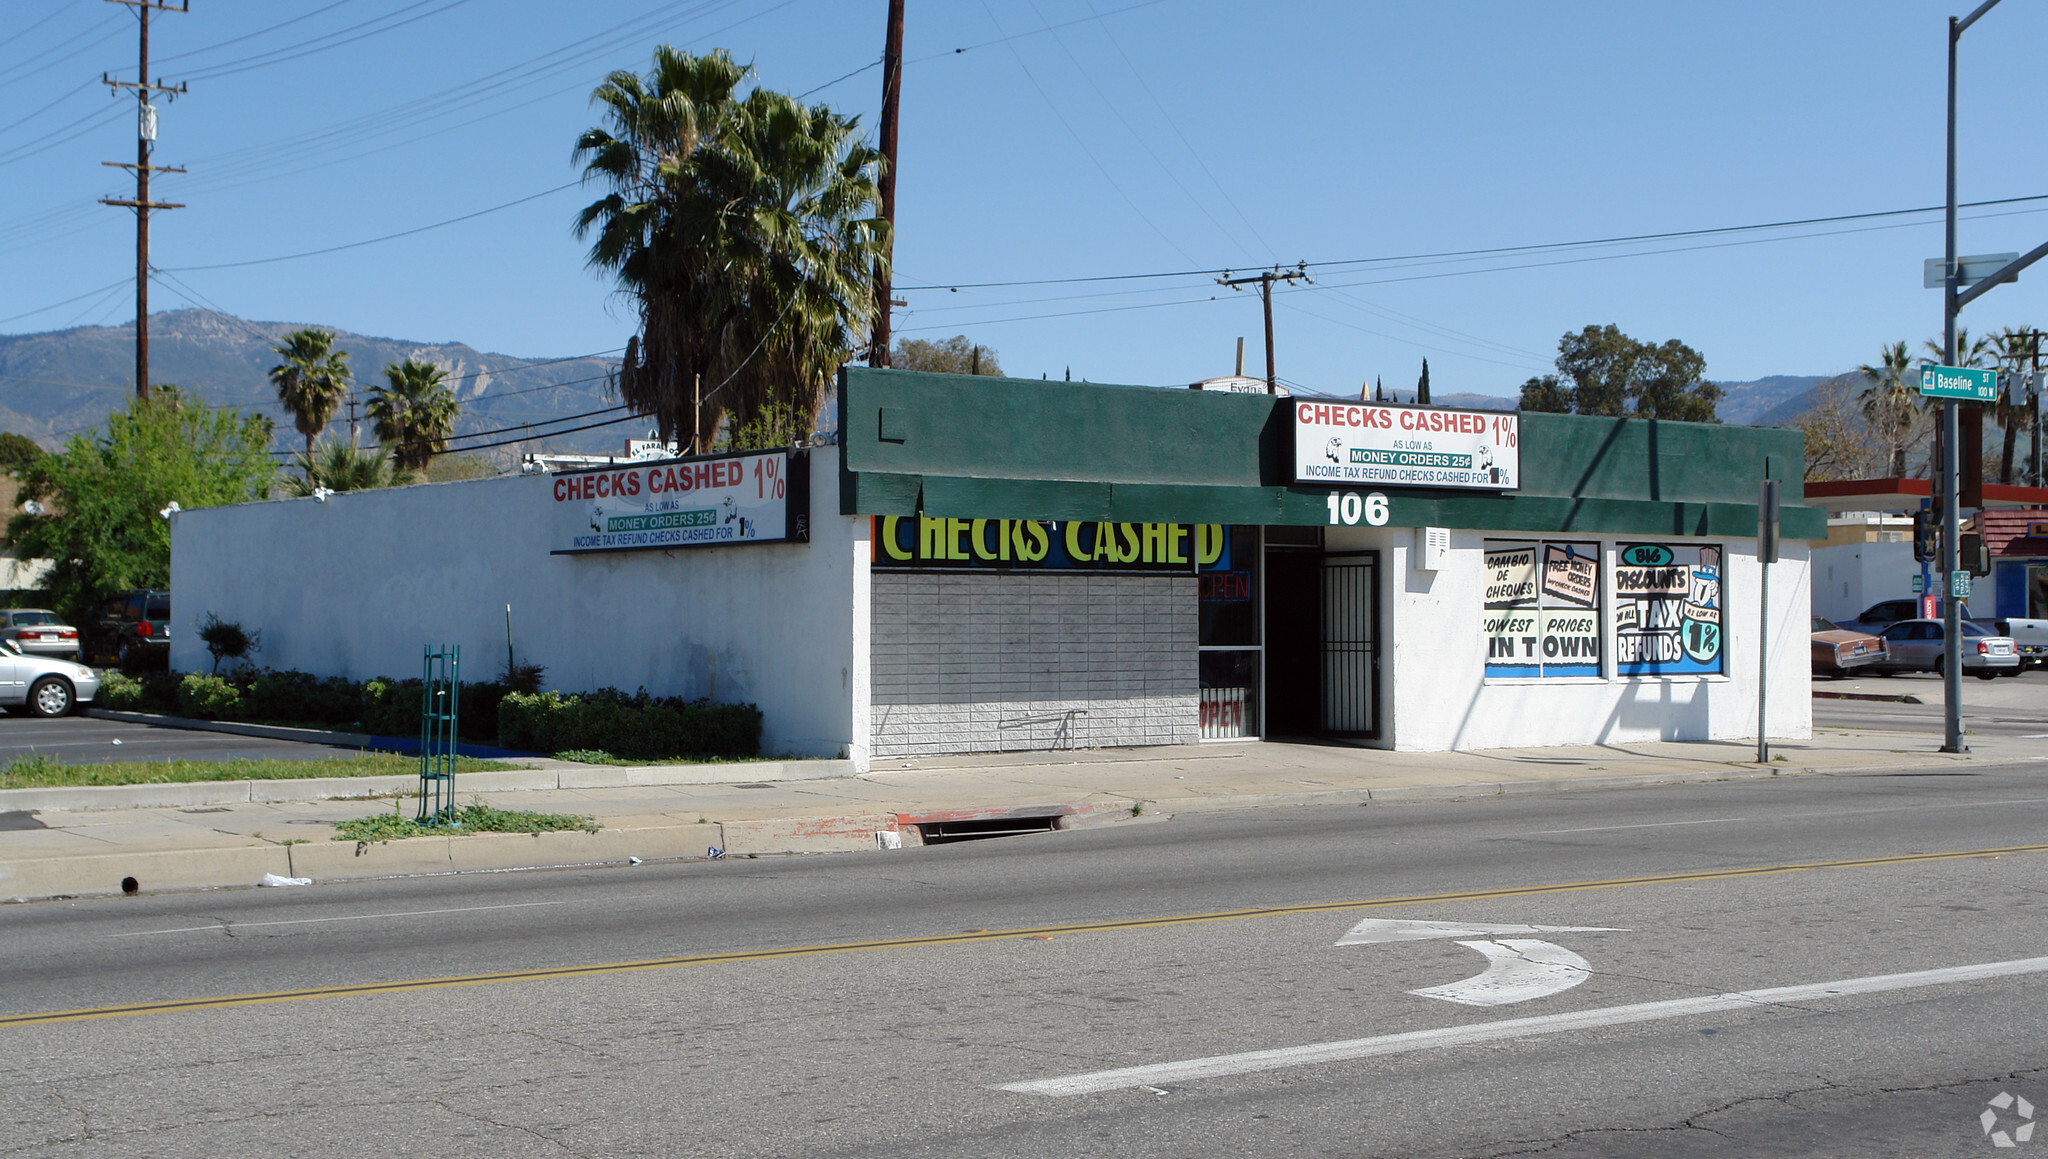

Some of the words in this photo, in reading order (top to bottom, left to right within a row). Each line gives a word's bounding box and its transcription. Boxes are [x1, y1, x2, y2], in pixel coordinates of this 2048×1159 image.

[1938, 373, 1973, 391] Baseline
[1982, 373, 1990, 383] ST
[1230, 382, 1263, 393] Evans
[1978, 386, 1987, 397] 100
[1988, 387, 1994, 397] W
[1298, 403, 1392, 429] CHECKS
[1399, 410, 1486, 434] CASHED
[1493, 415, 1516, 448] 1%
[1393, 439, 1403, 449] AS
[1405, 440, 1422, 450] LOW
[1423, 440, 1433, 451] AS
[1351, 450, 1398, 464] MONEY
[1399, 452, 1449, 466] ORDERS
[1452, 455, 1471, 468] 25¢
[553, 471, 641, 502] CHECKS
[648, 460, 743, 494] CASHED
[754, 456, 785, 500] 1%
[1305, 464, 1341, 478] INCOME
[1343, 466, 1360, 479] TAX
[1362, 467, 1397, 480] REFUND
[1399, 469, 1434, 482] CHECKS
[1436, 470, 1470, 483] CASHED
[1472, 472, 1489, 484] FOR
[1489, 467, 1510, 485] 1%
[644, 502, 654, 512] AS
[656, 501, 669, 512] LOW
[670, 500, 679, 510] AS
[1327, 491, 1390, 526] 106
[609, 516, 648, 531] MONEY
[650, 513, 694, 528] ORDERS
[696, 510, 716, 525] 25¢
[573, 534, 601, 548] INCOME
[602, 532, 616, 546] TAX
[617, 531, 647, 546] REFUND
[649, 529, 681, 544] CHECKS
[682, 527, 715, 542] CASHED
[716, 526, 733, 539] FOR
[739, 517, 756, 538] 1%
[882, 515, 1049, 562] CHECKS
[1064, 521, 1224, 565] CASHED
[1487, 553, 1528, 570] CAMBIO
[1635, 548, 1661, 563] BIG
[1496, 569, 1509, 582] DE
[1549, 559, 1569, 572] FREE
[1570, 560, 1592, 576] MONEY
[1198, 574, 1249, 600] OPEN
[1567, 571, 1591, 588] ORDERS
[1616, 568, 1686, 590] DISCOUNTS
[1486, 582, 1533, 599] CHEQUES
[1624, 609, 1635, 621] ALL
[1637, 599, 1681, 629] TAX
[1547, 618, 1593, 633] PRICES
[1689, 622, 1717, 653] 1%
[1489, 636, 1514, 658] IN
[1522, 636, 1597, 658] TOWN
[1618, 635, 1682, 662] REFUNDS
[1199, 701, 1243, 728] OPEN
